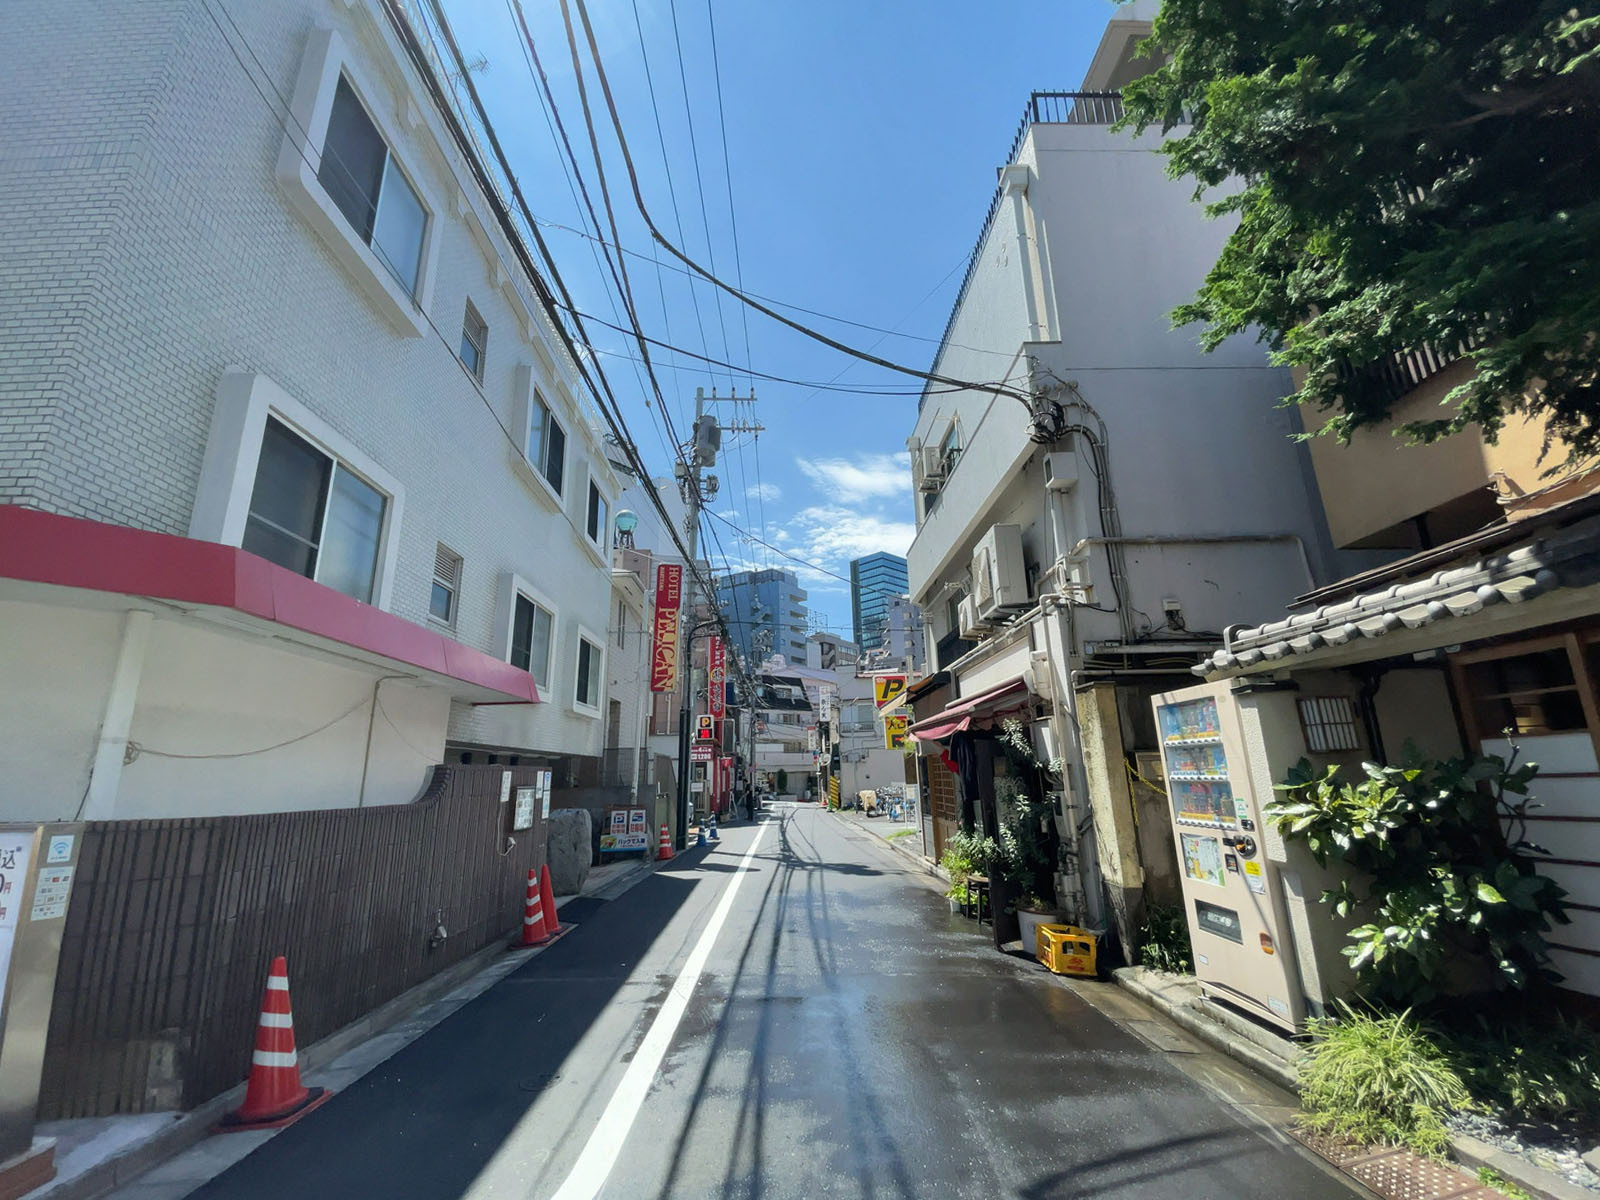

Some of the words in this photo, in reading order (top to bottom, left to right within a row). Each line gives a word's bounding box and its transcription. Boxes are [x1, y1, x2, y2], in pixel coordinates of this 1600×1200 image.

[668, 567, 680, 601] HOTEL
[654, 607, 677, 689] PELICAN
[882, 679, 904, 699] P
[701, 717, 710, 727] P
